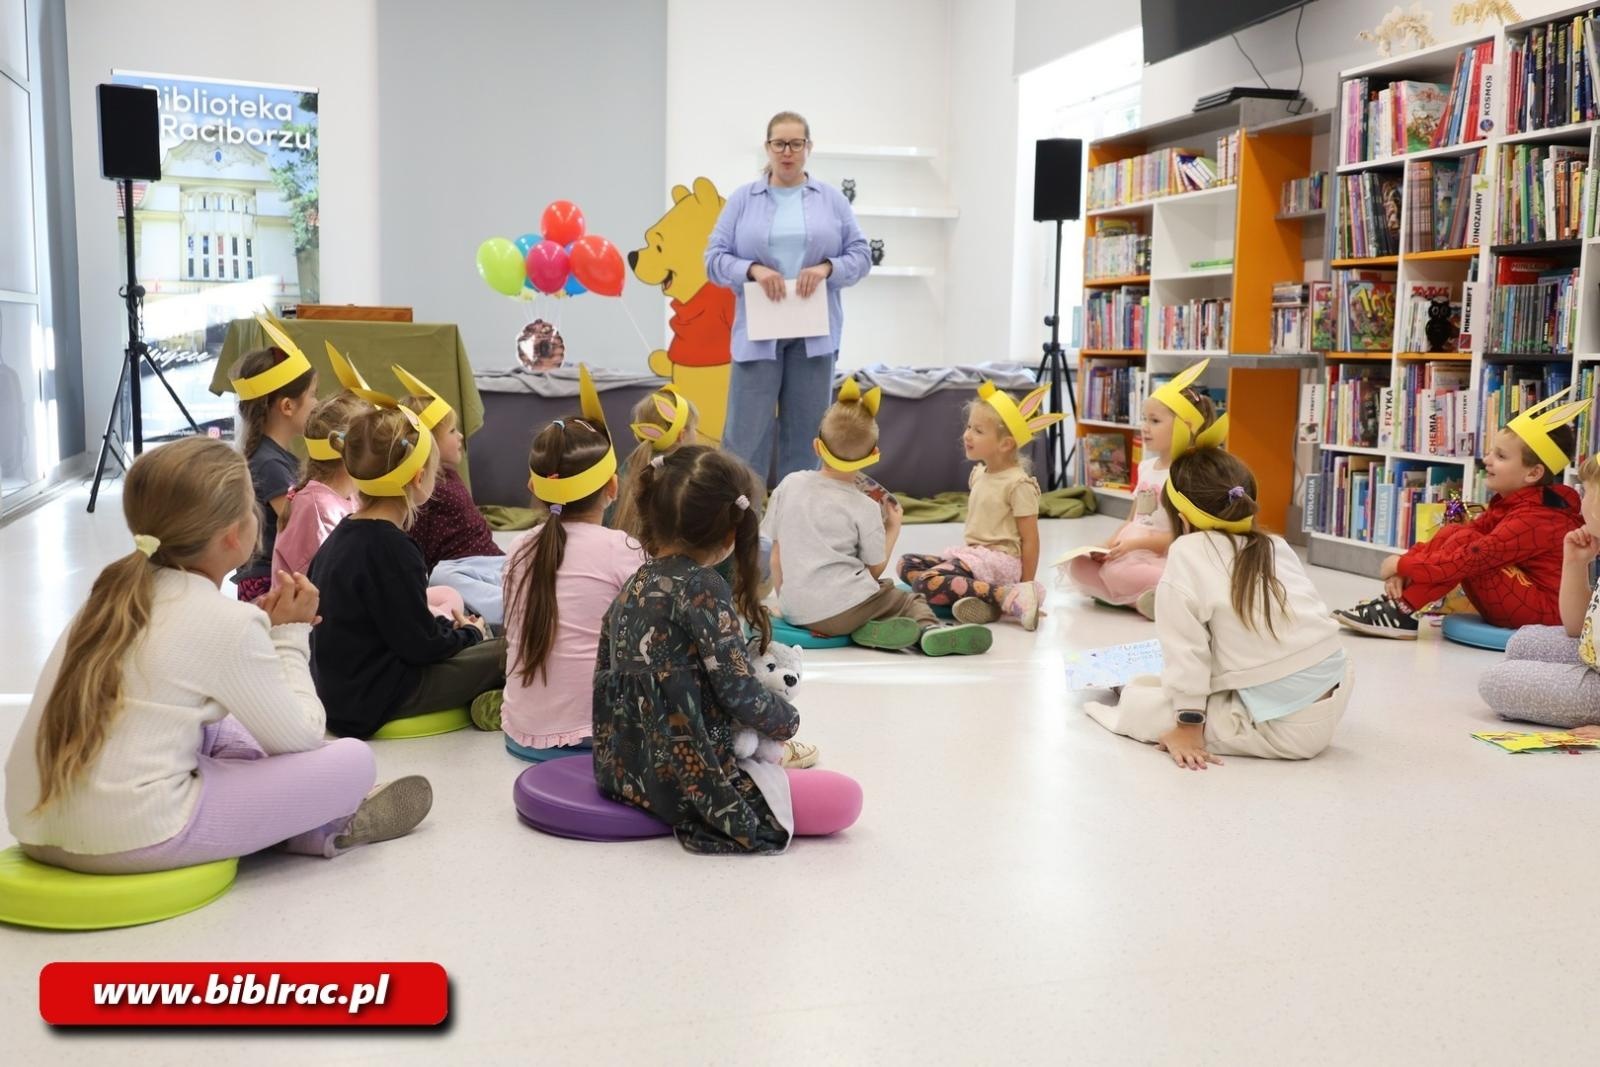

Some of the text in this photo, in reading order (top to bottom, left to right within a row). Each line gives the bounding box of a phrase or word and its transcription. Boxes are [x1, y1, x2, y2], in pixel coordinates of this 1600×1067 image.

[1484, 75, 1493, 116] KOSMOS
[160, 114, 311, 150] Raciborzu
[1472, 192, 1483, 244] DINOZAURY
[1464, 286, 1473, 333] MINECRAFT
[1384, 389, 1393, 426] FIZYKA
[1429, 413, 1437, 454] CHEMIA
[1306, 478, 1315, 525] MITOLOGIA
[1378, 491, 1389, 536] RELIGIA
